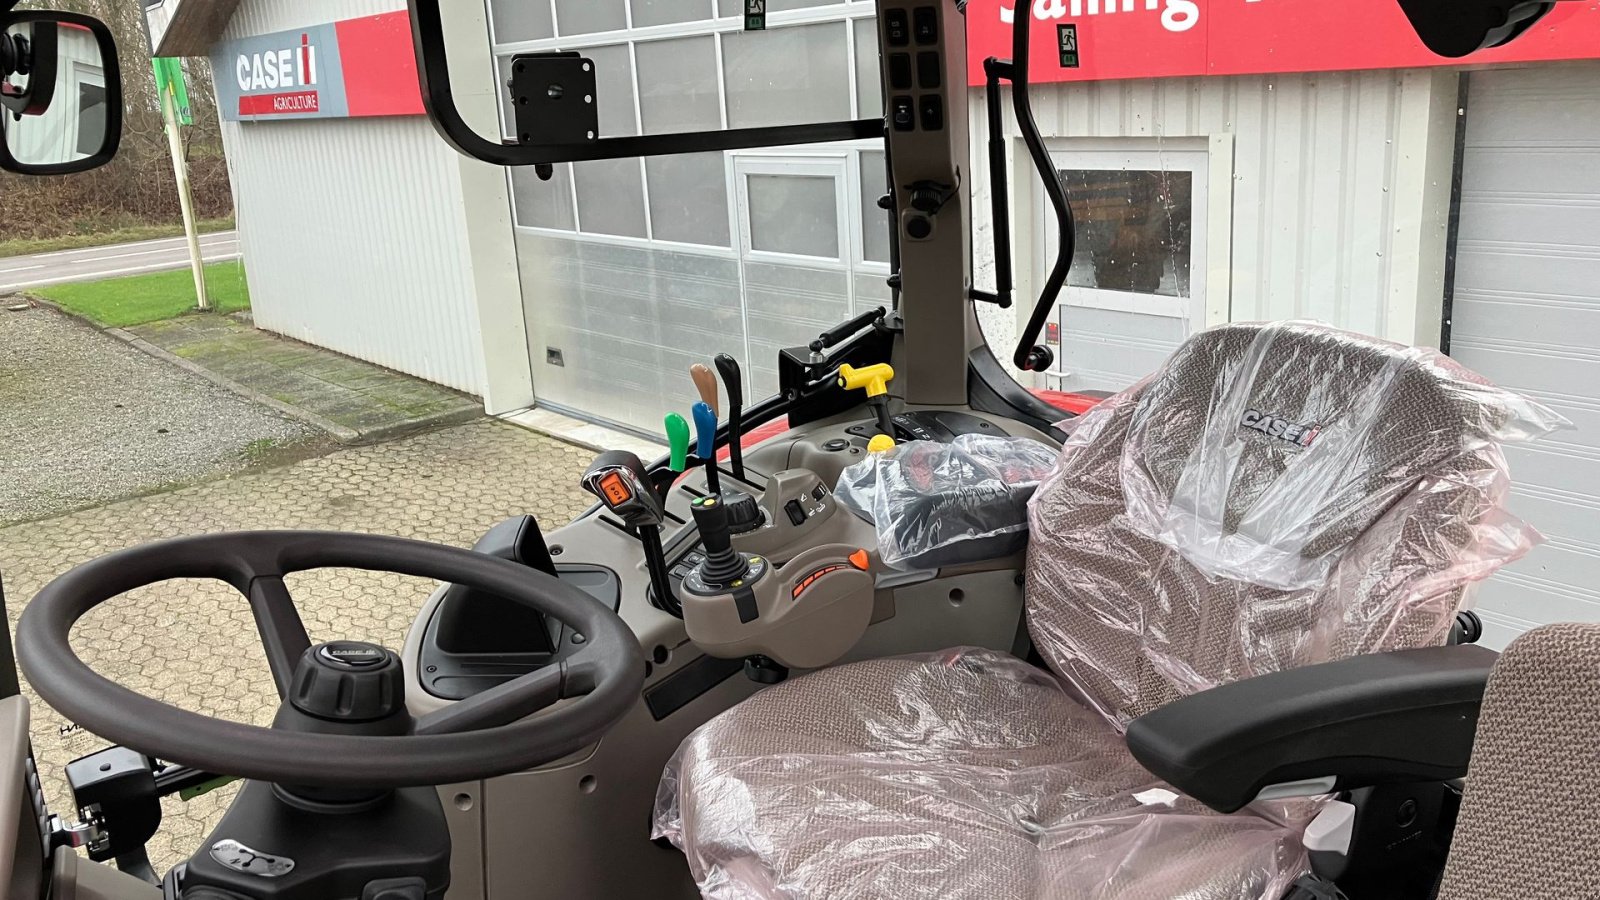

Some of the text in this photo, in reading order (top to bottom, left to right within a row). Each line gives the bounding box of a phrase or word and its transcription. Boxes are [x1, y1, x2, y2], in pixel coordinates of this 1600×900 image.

[236, 49, 294, 91] CASE
[273, 94, 318, 111] AGRICULTURE
[1240, 409, 1304, 442] CASE
